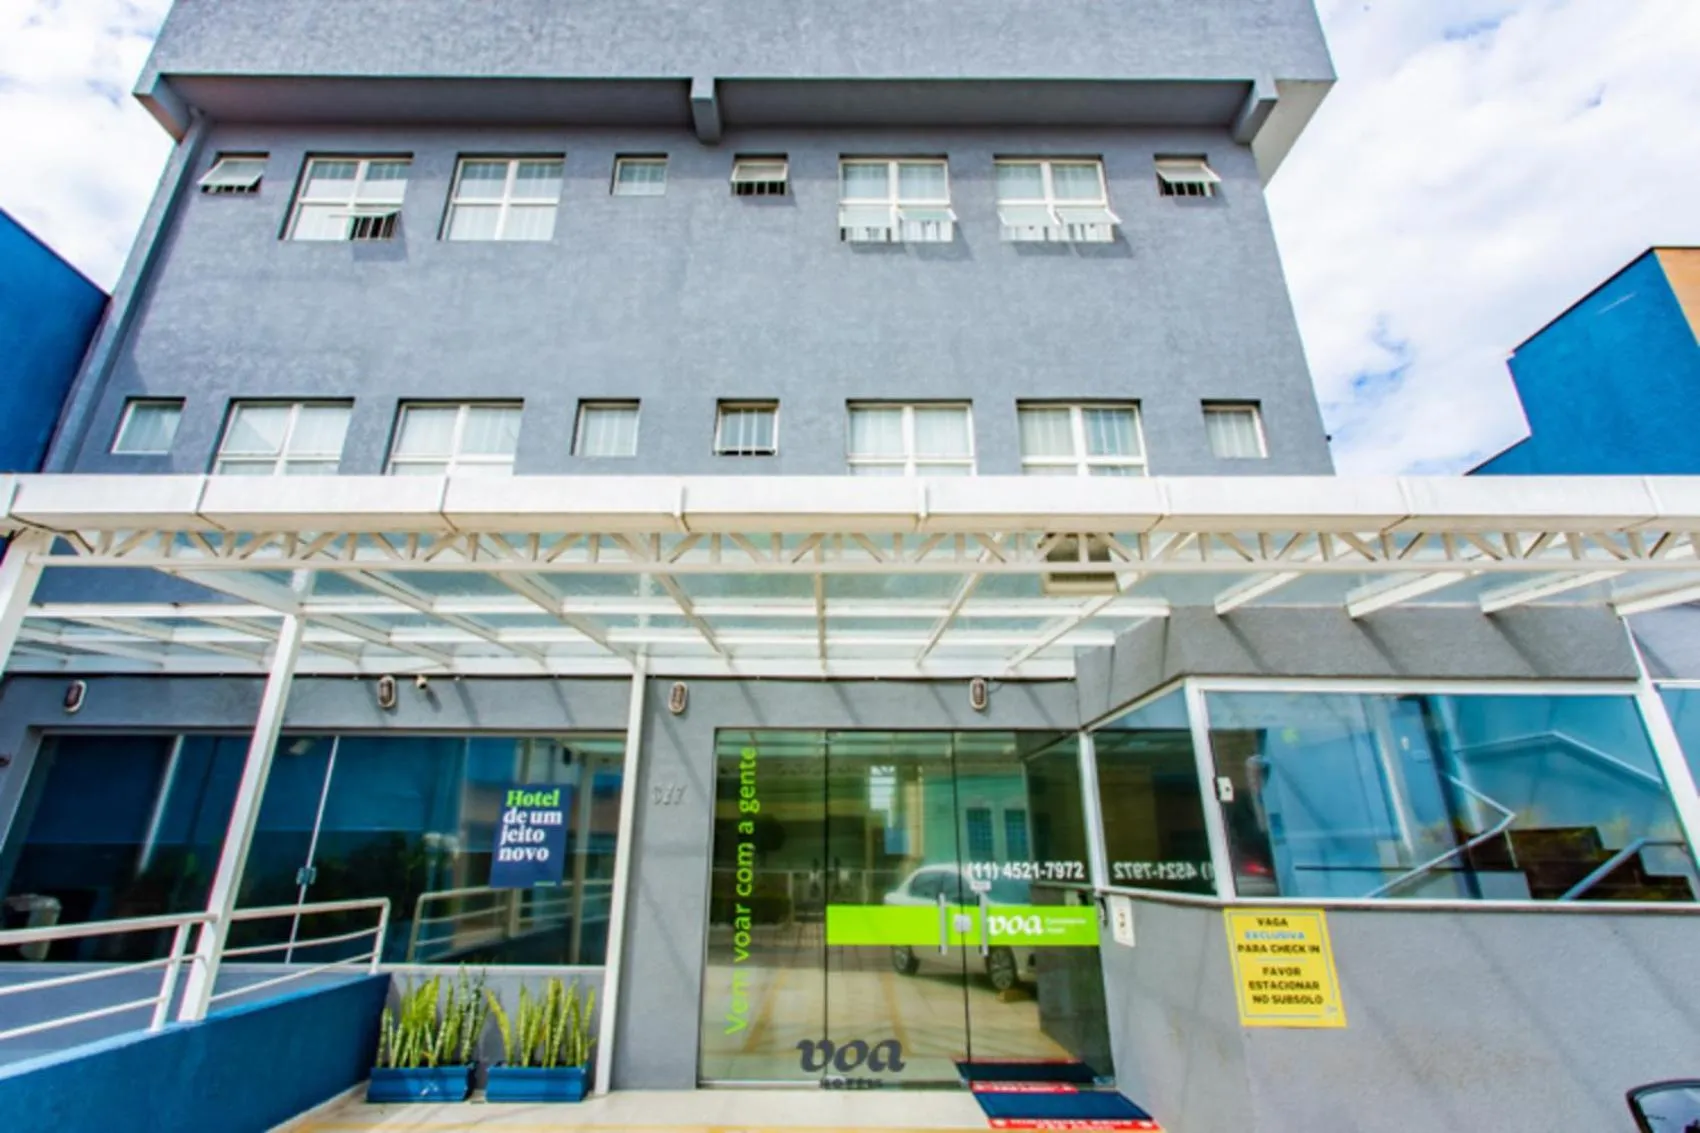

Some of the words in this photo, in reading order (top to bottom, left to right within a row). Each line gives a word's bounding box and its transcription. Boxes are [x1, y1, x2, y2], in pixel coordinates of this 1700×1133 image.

[738, 747, 760, 814] gente
[506, 788, 560, 807] Hotel
[503, 806, 528, 824] de
[530, 811, 562, 825] um
[499, 823, 545, 846] jeito
[738, 821, 755, 835] a
[498, 846, 549, 862] novo
[736, 842, 755, 896] com
[967, 861, 999, 880] (11)
[1003, 861, 1085, 880] 4521-7972
[986, 914, 1044, 937] voa
[1256, 917, 1289, 928] VAGA
[734, 903, 751, 962] voar
[1236, 943, 1268, 953] PARA
[1270, 943, 1307, 953] CHECK
[1309, 944, 1320, 953] IN
[1261, 966, 1302, 977] FAVOR
[1248, 980, 1321, 991] ESTACIONAR
[724, 969, 749, 1035] Vem
[1252, 994, 1270, 1004] NO
[1271, 994, 1324, 1005] SUBSOLO
[796, 1038, 906, 1073] voa
